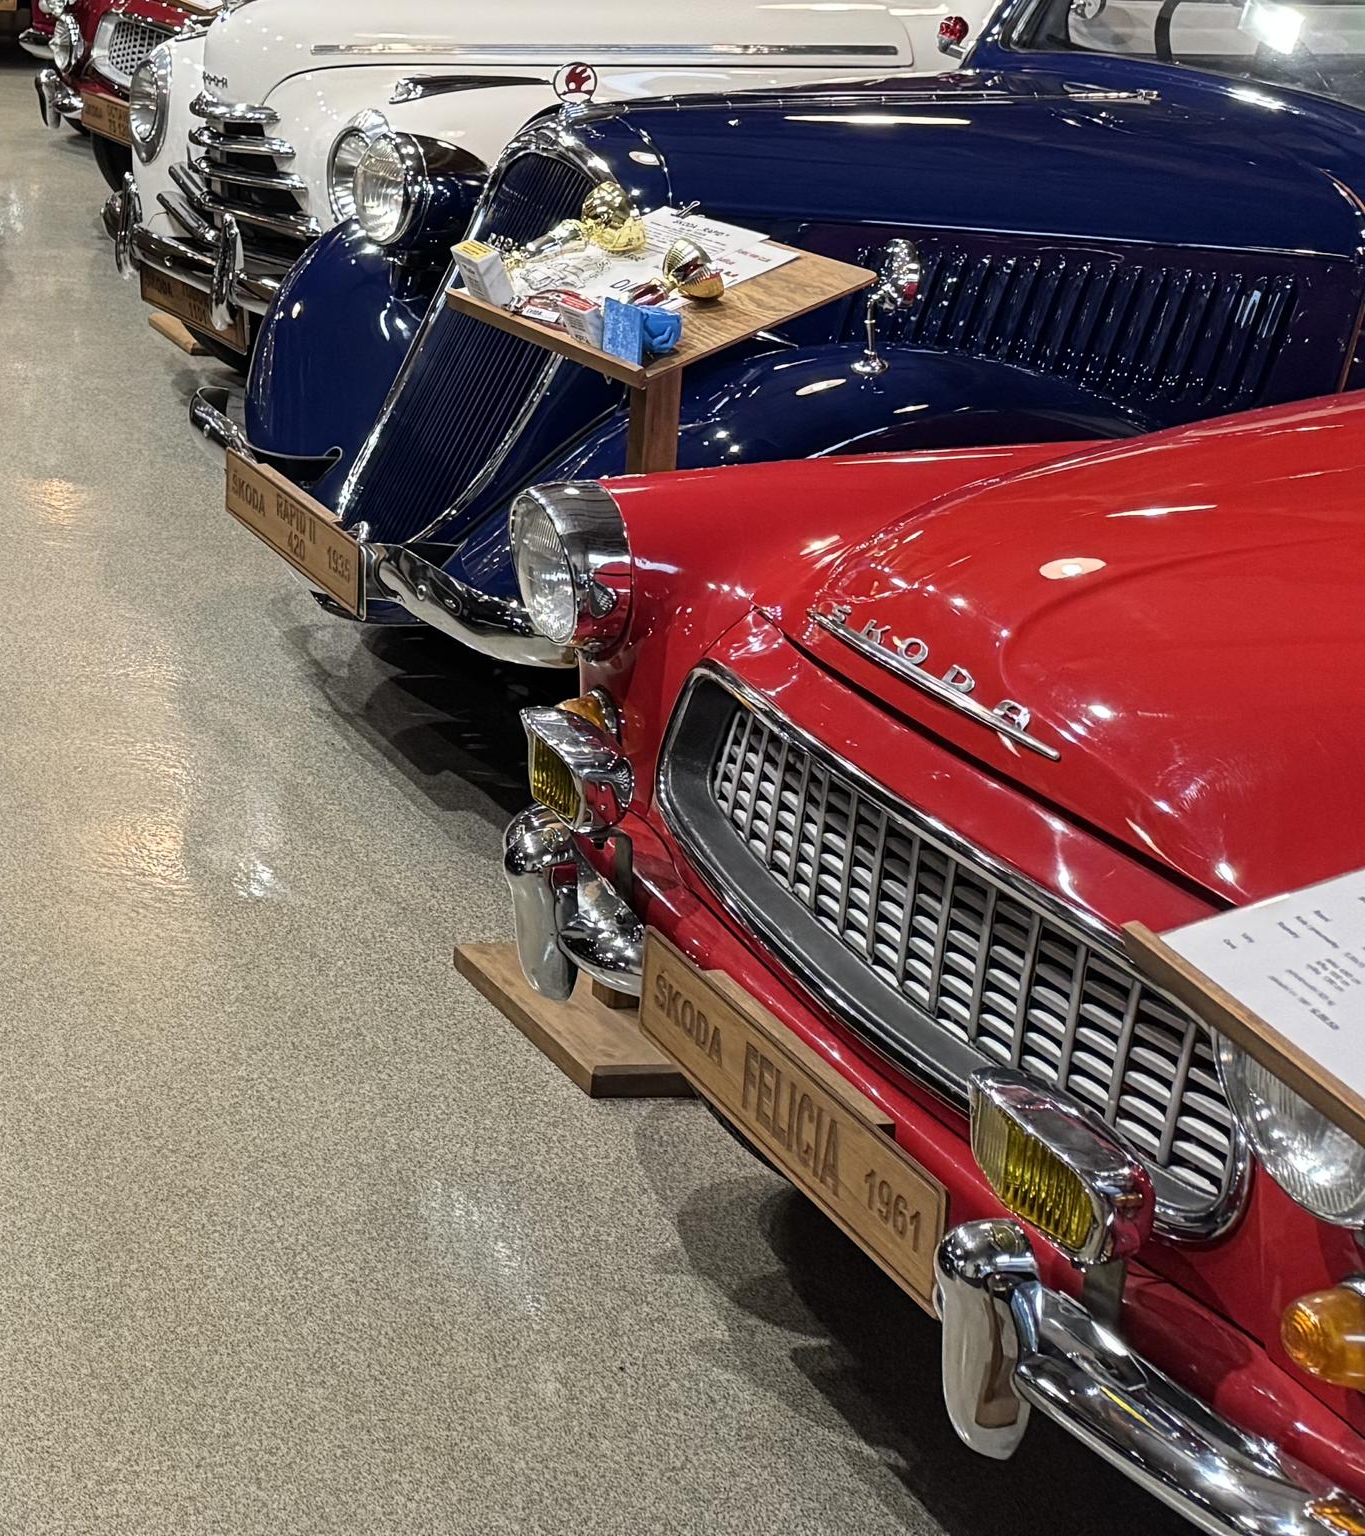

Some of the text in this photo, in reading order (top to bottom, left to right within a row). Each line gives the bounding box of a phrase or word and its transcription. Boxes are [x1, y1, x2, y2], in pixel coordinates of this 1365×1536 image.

[232, 470, 266, 517] ŠKODA
[276, 490, 307, 536] RAPID
[287, 530, 306, 562] 420
[653, 968, 922, 1253] ŠKODA FELICIA 1961
